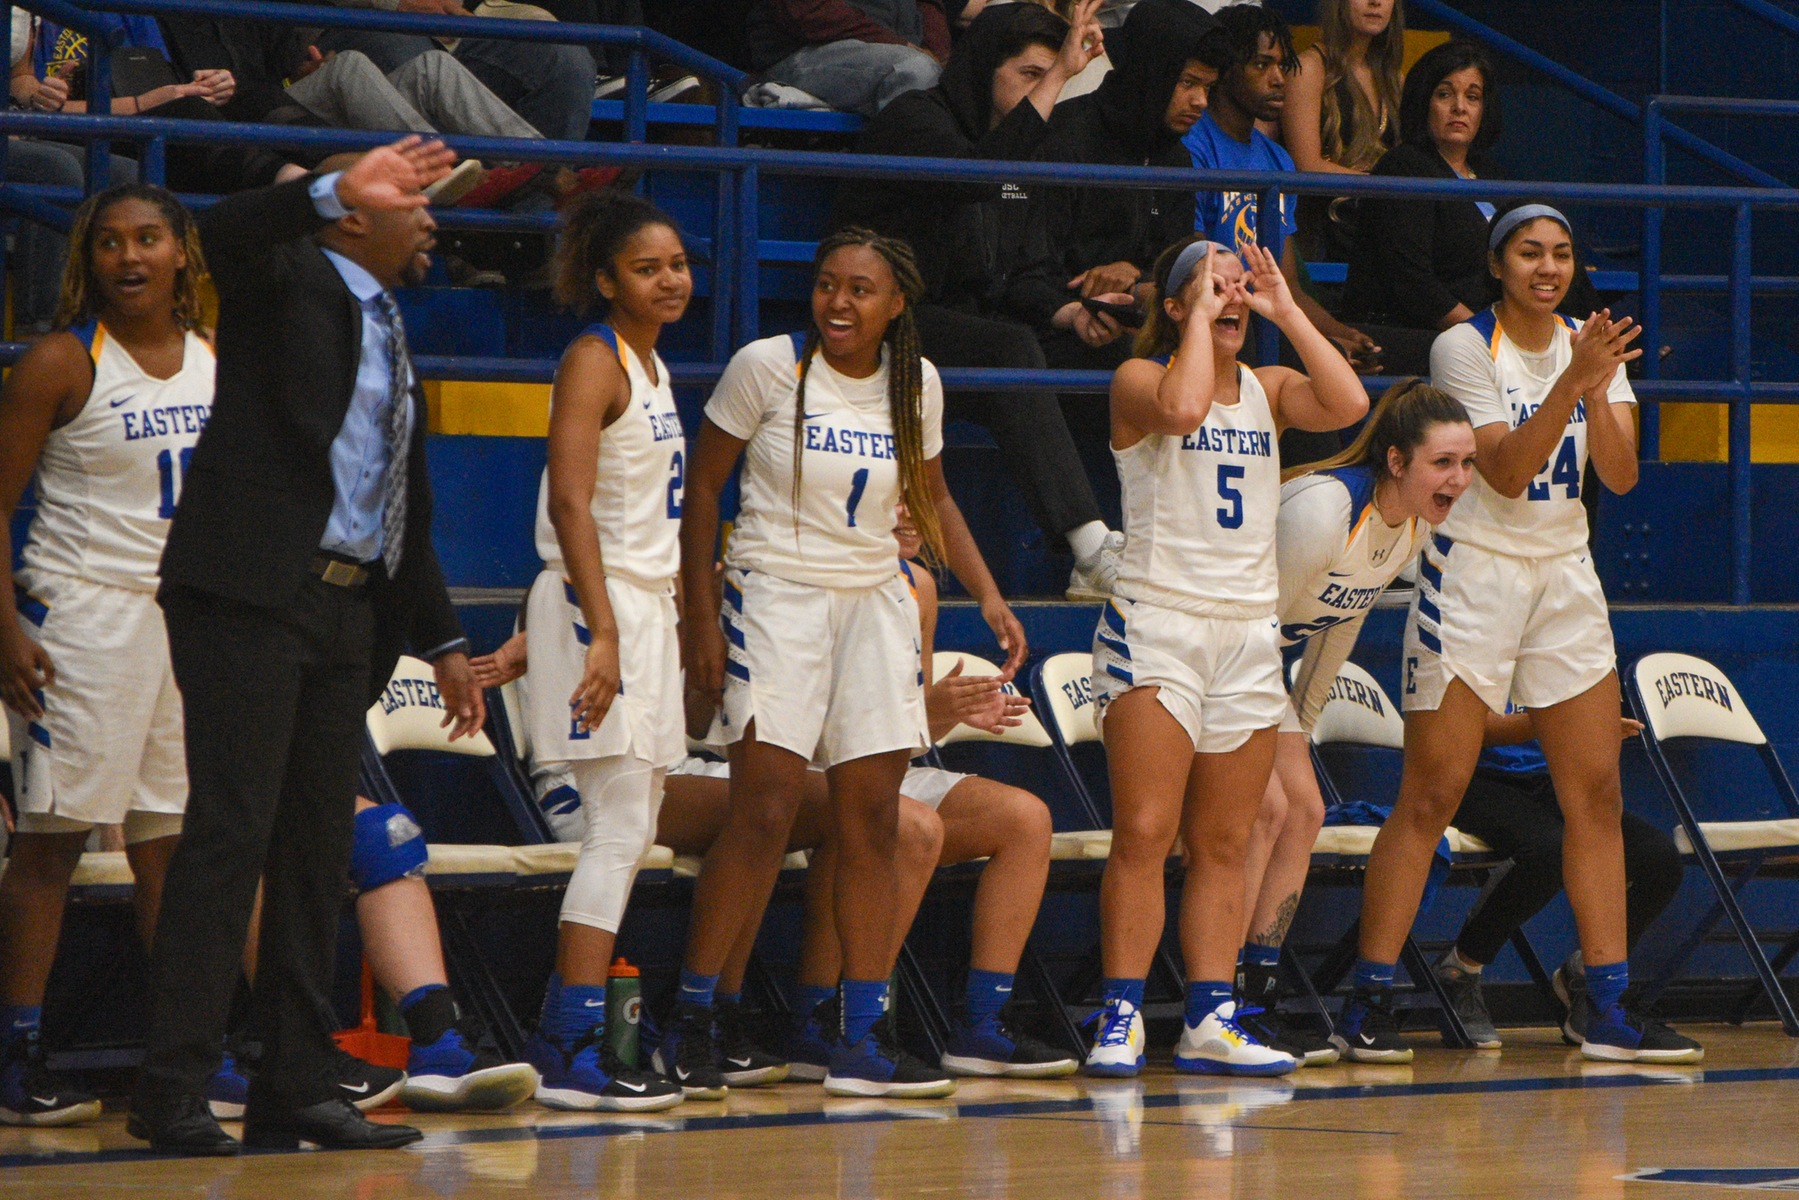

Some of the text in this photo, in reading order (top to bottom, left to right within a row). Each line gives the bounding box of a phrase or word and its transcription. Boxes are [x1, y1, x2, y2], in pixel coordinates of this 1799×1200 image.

[122, 405, 212, 440] EASTER
[806, 425, 897, 460] EASTER
[1181, 426, 1271, 457] EASTERN
[1528, 436, 1580, 501] 24
[846, 468, 868, 527] 1
[1217, 464, 1245, 529] 5
[1318, 583, 1384, 609] EASTER
[1406, 657, 1418, 694] E
[1655, 672, 1733, 713] EASTERN
[380, 679, 447, 715] EASTER
[1321, 676, 1385, 718] STERN
